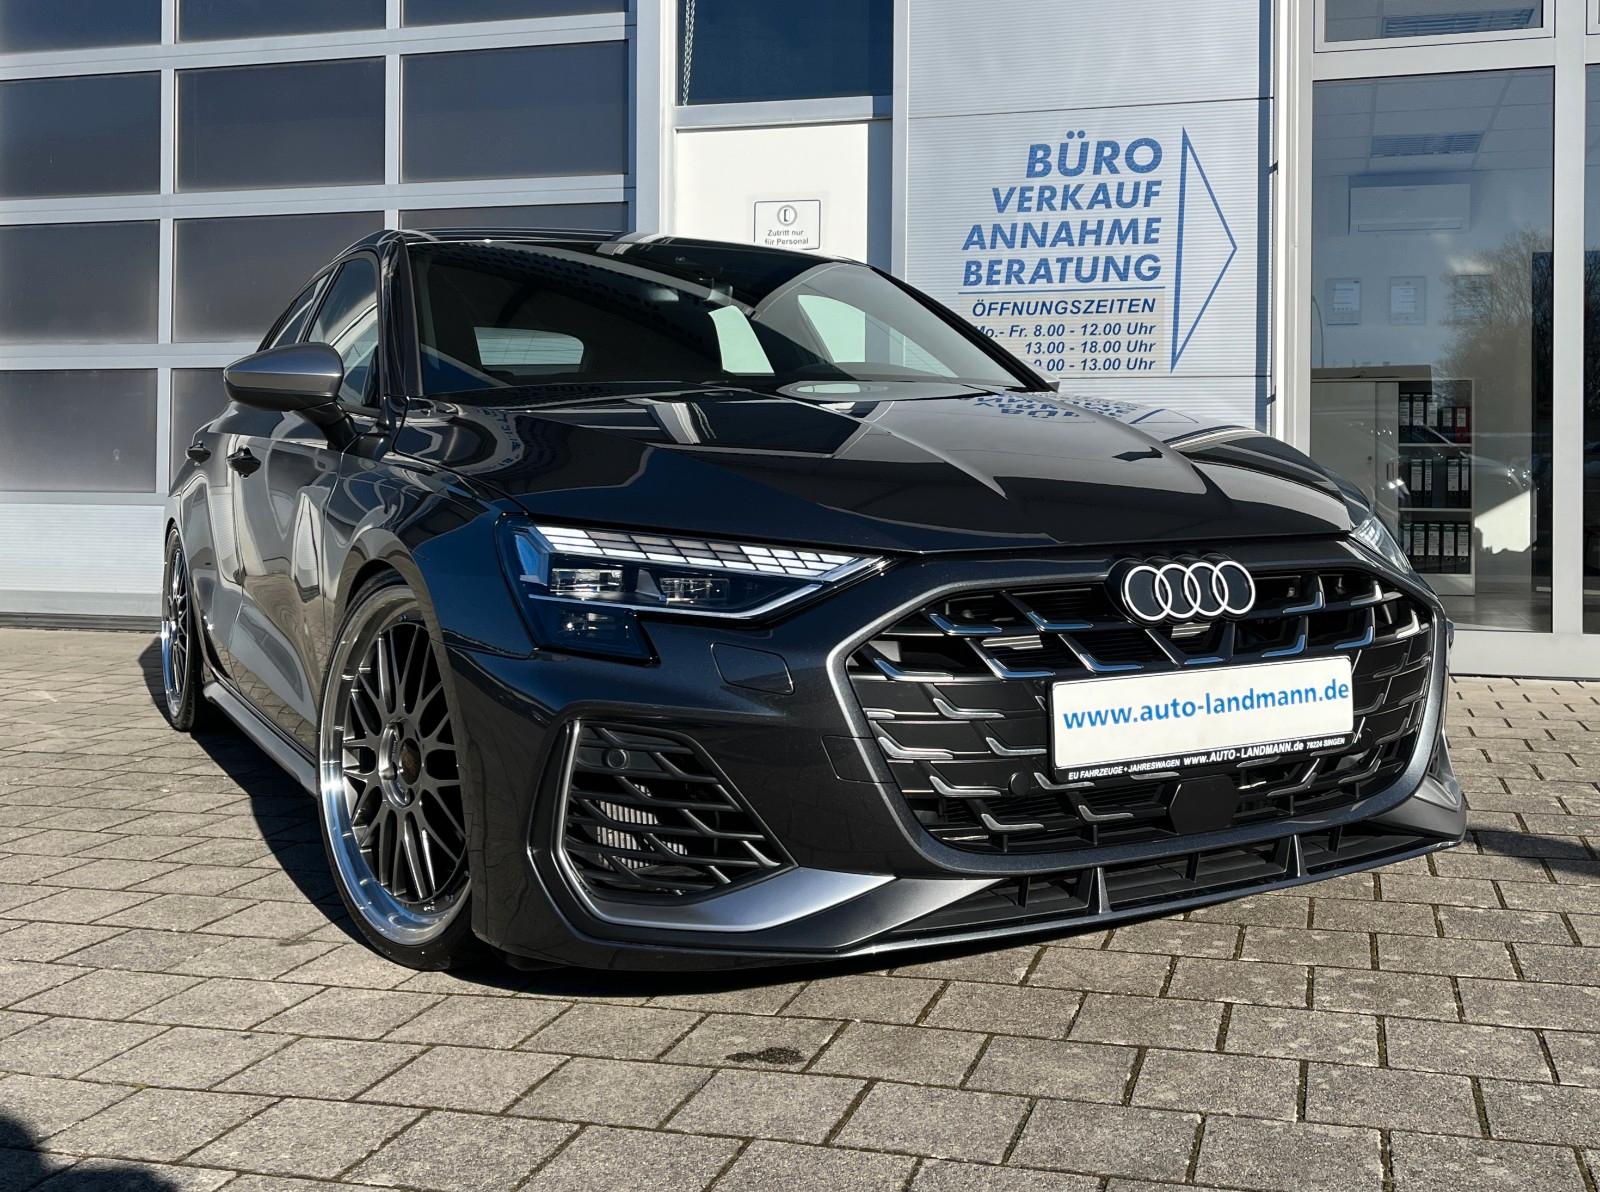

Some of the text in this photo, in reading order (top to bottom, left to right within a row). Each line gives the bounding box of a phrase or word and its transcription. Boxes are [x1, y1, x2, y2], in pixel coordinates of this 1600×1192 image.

[1026, 130, 1163, 178] BÜRO
[992, 180, 1162, 213] VERKAUF
[776, 237, 808, 245] Personal
[962, 217, 1162, 250] ANNAHME
[963, 254, 1162, 286] BERATUNG
[972, 298, 1156, 317] ÖFFNUNGSZEITEN
[1009, 324, 1028, 338] Fr.
[1033, 324, 1065, 337] 8.00
[1081, 323, 1121, 336] 12.00
[1127, 322, 1156, 335] Uhr
[1025, 341, 1065, 354] 13.00
[1081, 341, 1121, 353] 18.00
[1127, 340, 1156, 353] Uhr
[1081, 358, 1121, 371] 13.00
[1127, 358, 1156, 370] Uhr
[1063, 679, 1349, 730] www.auto-landmann.de
[1068, 771, 1079, 780] EU
[1080, 766, 1124, 779] FAHRZEUGE
[1128, 759, 1181, 773] JAHRESWAGEN
[1323, 737, 1346, 747] SINGEN
